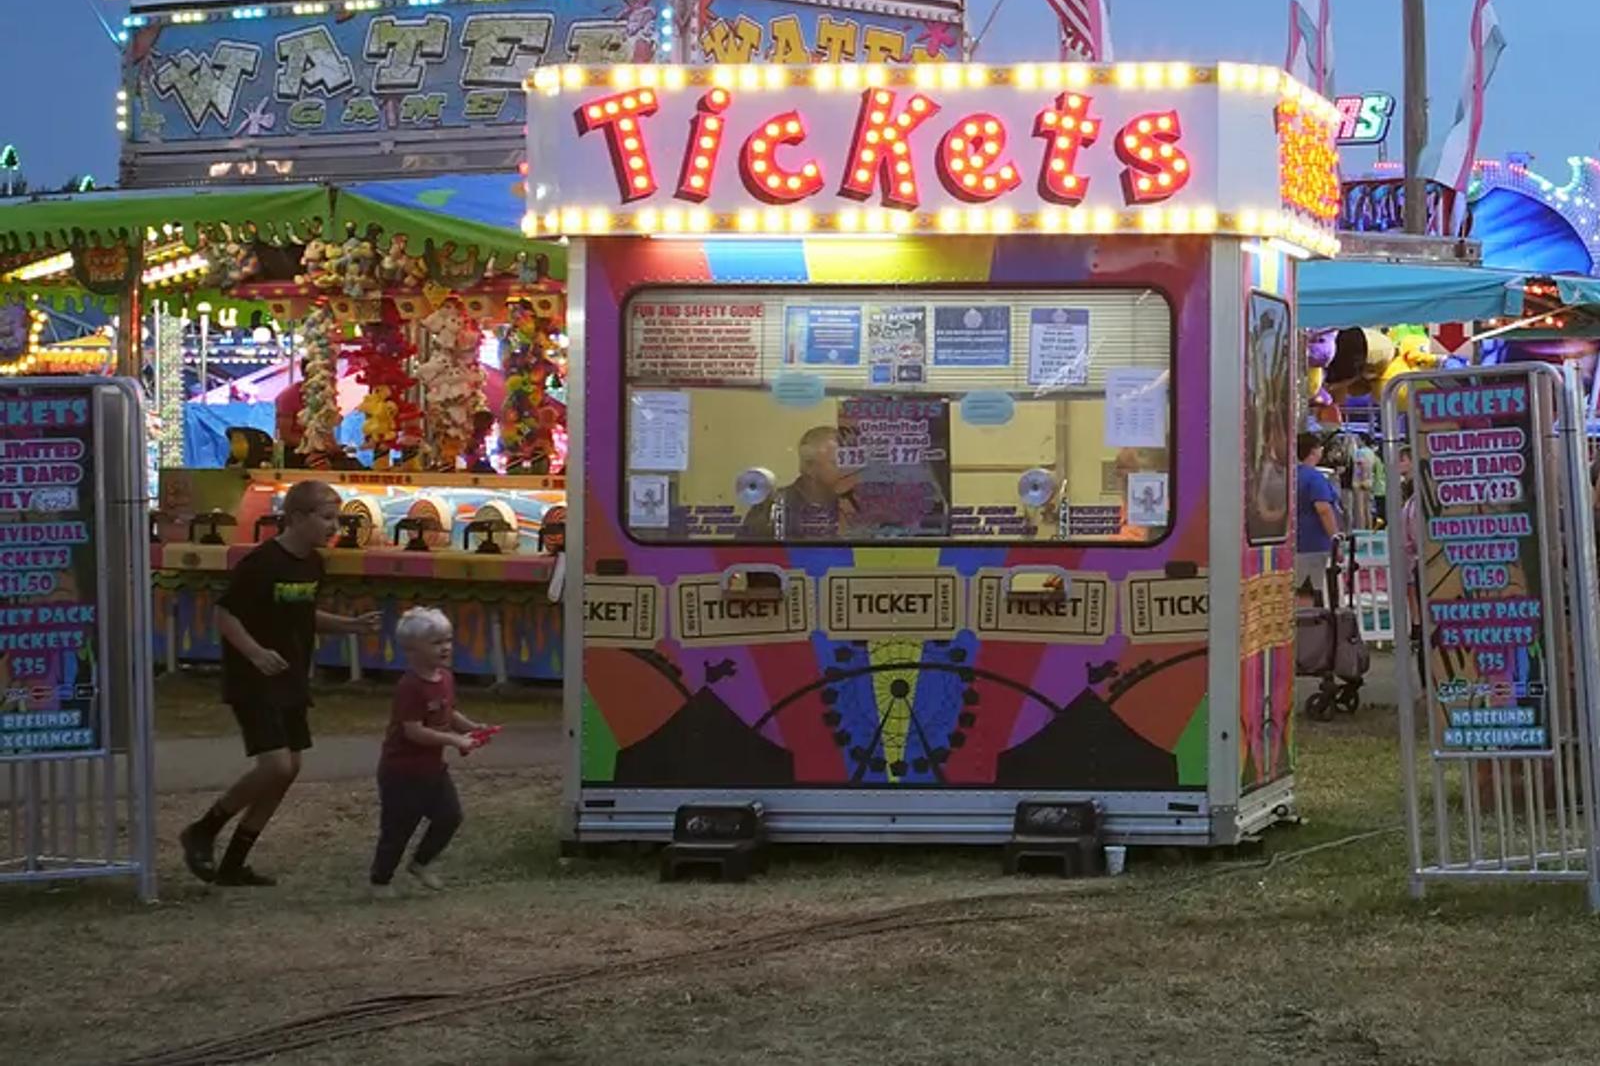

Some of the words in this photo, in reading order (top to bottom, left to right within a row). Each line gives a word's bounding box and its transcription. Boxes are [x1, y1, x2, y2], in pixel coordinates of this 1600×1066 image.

[574, 86, 1192, 210] Tickets
[684, 305, 727, 318] SAFETY
[0, 400, 87, 425] KETS
[1420, 387, 1526, 418] TICKETS
[0, 442, 81, 459] IMITED
[1431, 431, 1522, 452] UNLIMITED
[1433, 458, 1474, 477] RIDE
[1477, 456, 1523, 475] BAND
[1440, 483, 1487, 502] ONLY
[1432, 517, 1529, 536] INDIVIDUAL
[1446, 542, 1517, 560] TICKETS
[703, 596, 781, 621] TICKET
[852, 593, 933, 614] TICKET
[1153, 595, 1208, 616] TICK
[1431, 602, 1493, 621] TICKET
[1494, 601, 1541, 619] PACK
[37, 605, 96, 623] PACK
[1464, 626, 1534, 644] TICKETS
